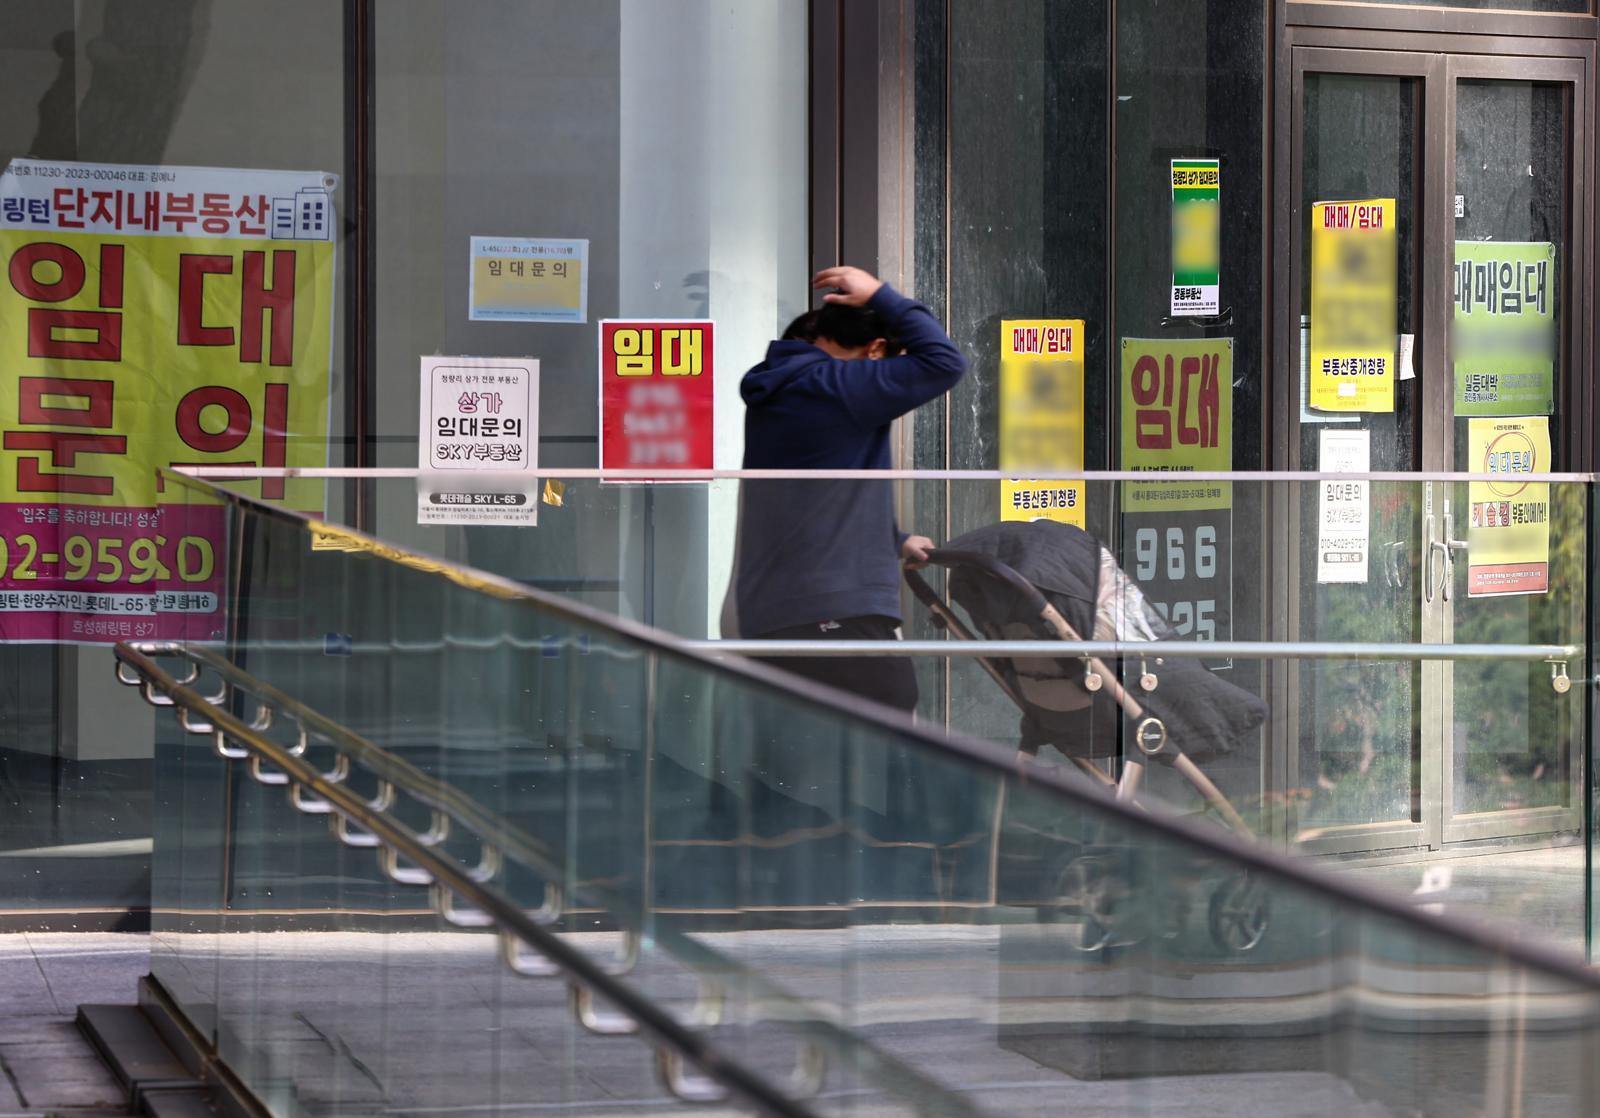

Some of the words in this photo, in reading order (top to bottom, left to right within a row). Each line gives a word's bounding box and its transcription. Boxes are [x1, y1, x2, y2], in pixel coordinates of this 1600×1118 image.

[34, 167, 127, 182] 11230-2023-00046
[1324, 205, 1383, 229] 매매/임대
[1174, 287, 1202, 300] 경동부동산
[1013, 327, 1072, 354] 매매/임대
[612, 328, 704, 376] 임대
[1322, 358, 1385, 376] 부동산중개청량
[1465, 374, 1498, 392] 일등대박
[458, 392, 503, 414] 상가
[1131, 353, 1220, 449] 임대
[437, 417, 522, 438] 임대문의
[436, 443, 522, 462] SKY부동산
[440, 493, 472, 504] 롯데캐슬
[474, 495, 492, 504] SKY
[493, 495, 517, 504] L-65
[1013, 489, 1076, 510] 부동산중개청량
[1326, 484, 1362, 501] 임대문의
[64, 510, 133, 527] 축하합니다!
[0, 535, 158, 584] 2-959
[1136, 525, 1217, 581] 966
